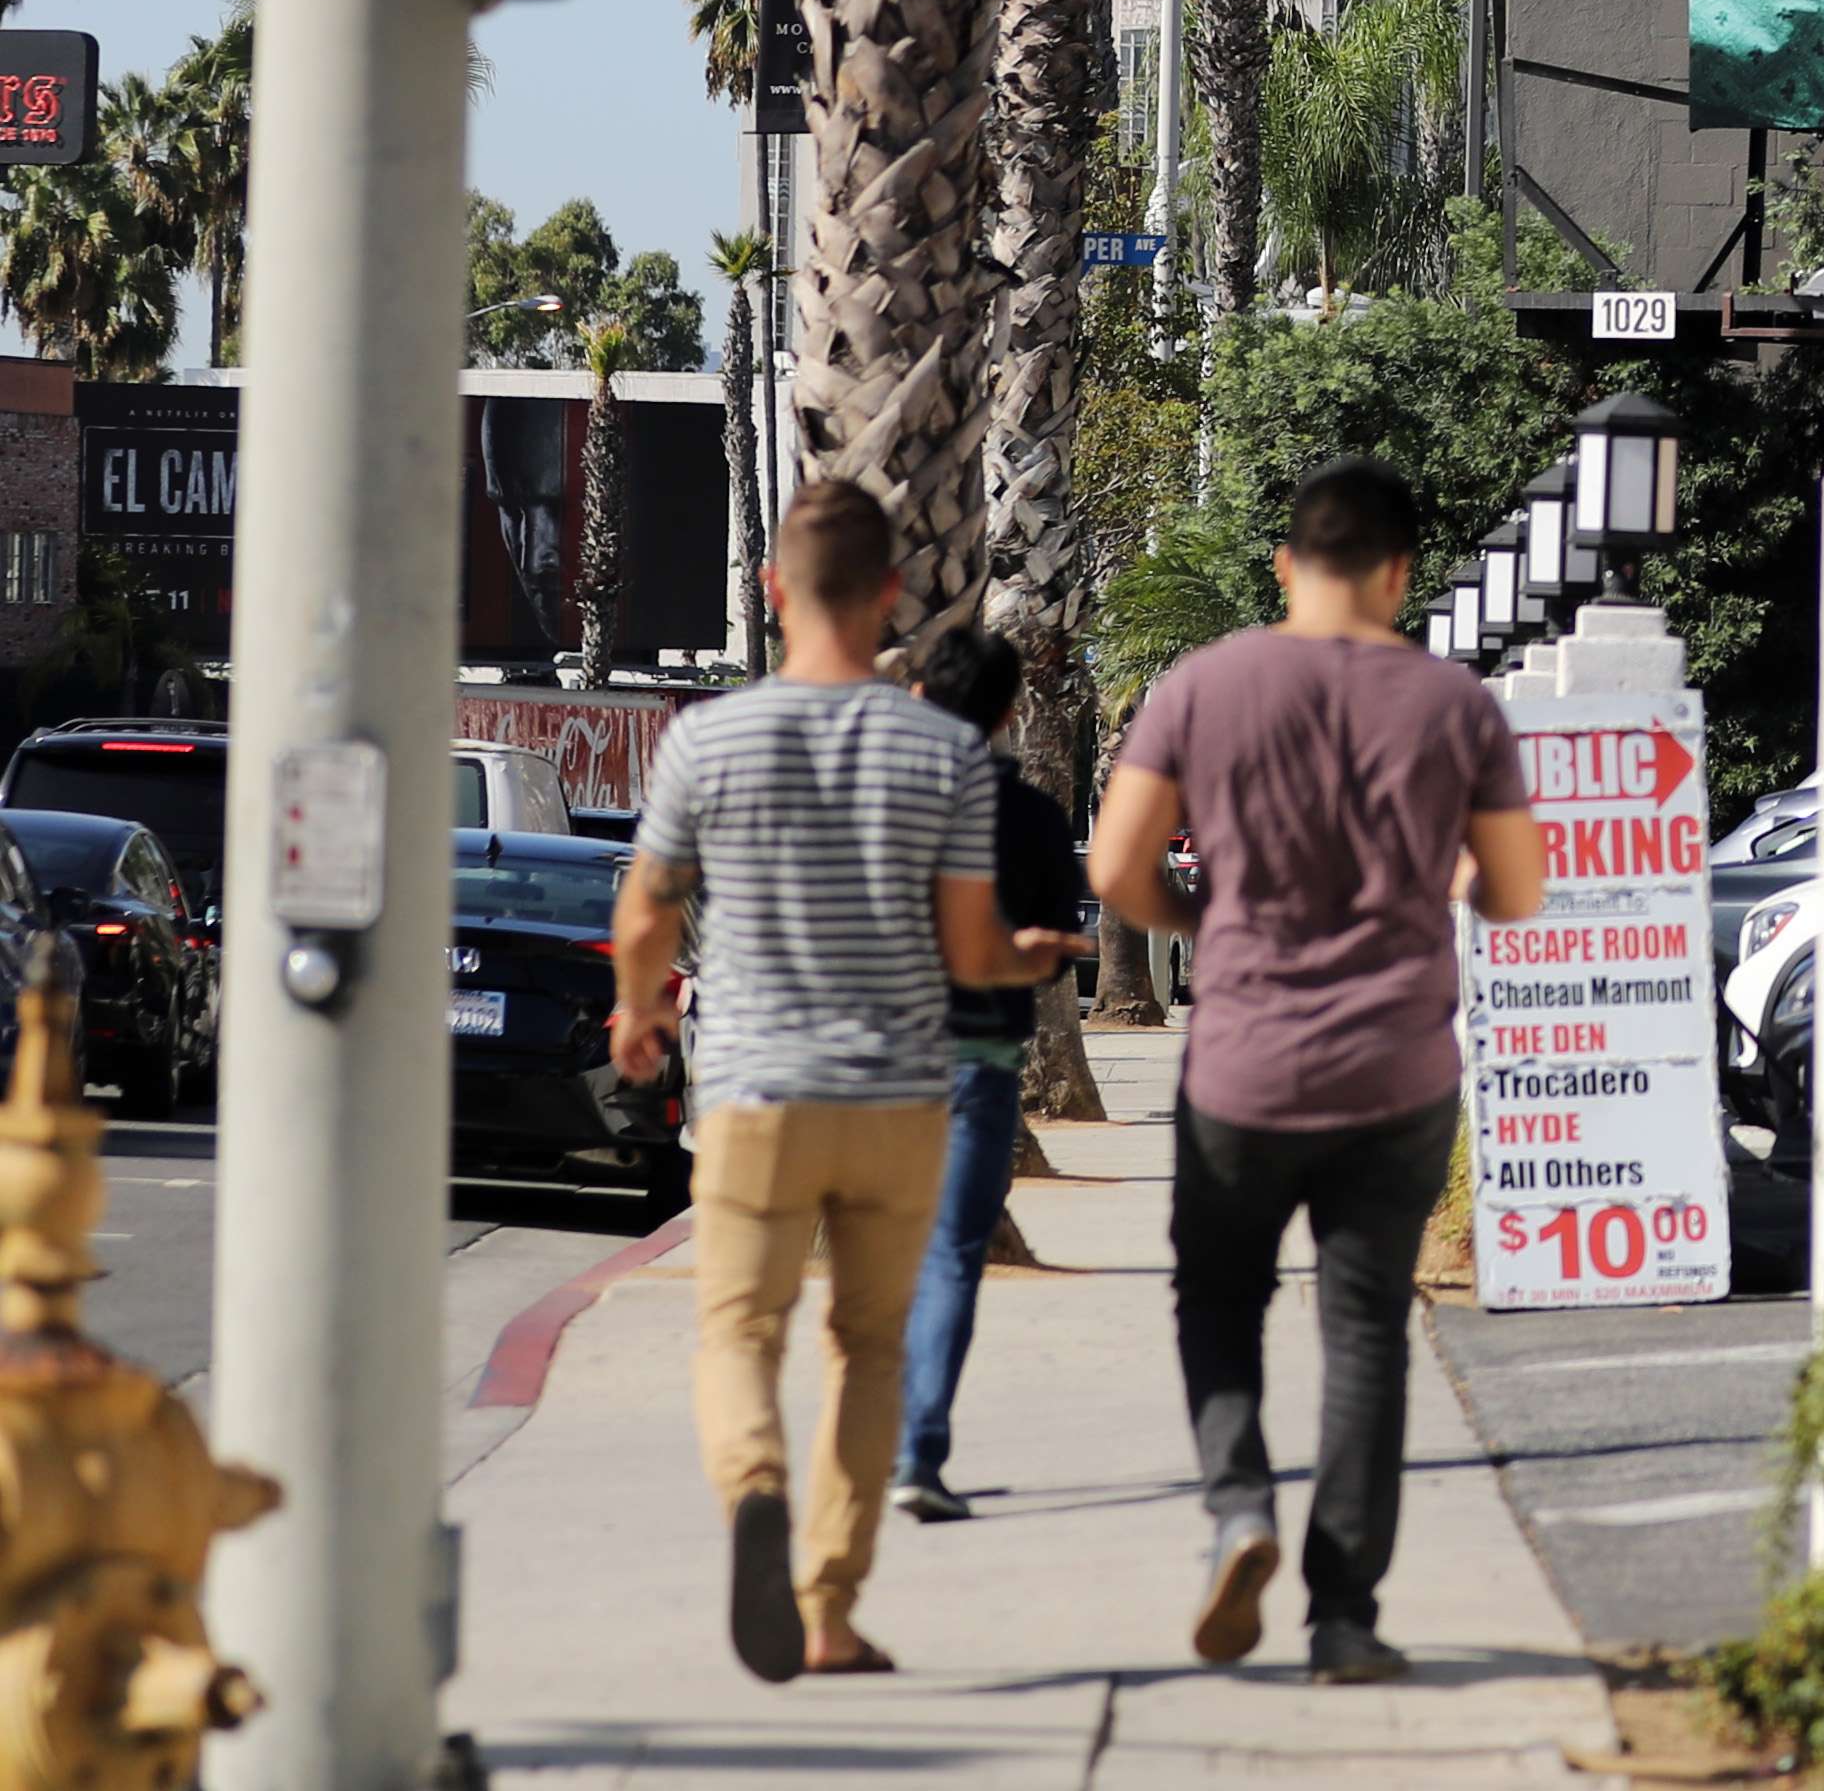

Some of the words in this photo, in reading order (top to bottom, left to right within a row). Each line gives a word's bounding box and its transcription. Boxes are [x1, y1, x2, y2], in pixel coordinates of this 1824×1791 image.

[1083, 237, 1124, 261] PER
[1134, 238, 1157, 251] AVE
[1601, 297, 1667, 333] 1029
[146, 410, 209, 418] NETFLIX
[103, 449, 146, 513] EL
[159, 449, 239, 515] CAM
[112, 543, 208, 556] BREAKING
[167, 590, 190, 610] 11
[1518, 733, 1657, 800] BLIC
[1536, 815, 1702, 878] RKING
[1489, 927, 1595, 966] ESCAPE
[1603, 923, 1688, 960] ROOM
[1491, 979, 1584, 1009] Chateau
[1591, 975, 1693, 1006] Marmont
[1492, 1024, 1544, 1055] THE
[1553, 1022, 1606, 1053] DEN
[1494, 1068, 1649, 1099] Trocadero
[1497, 1113, 1581, 1145] HYDE
[1499, 1161, 1535, 1190] All
[1546, 1158, 1644, 1188] Others
